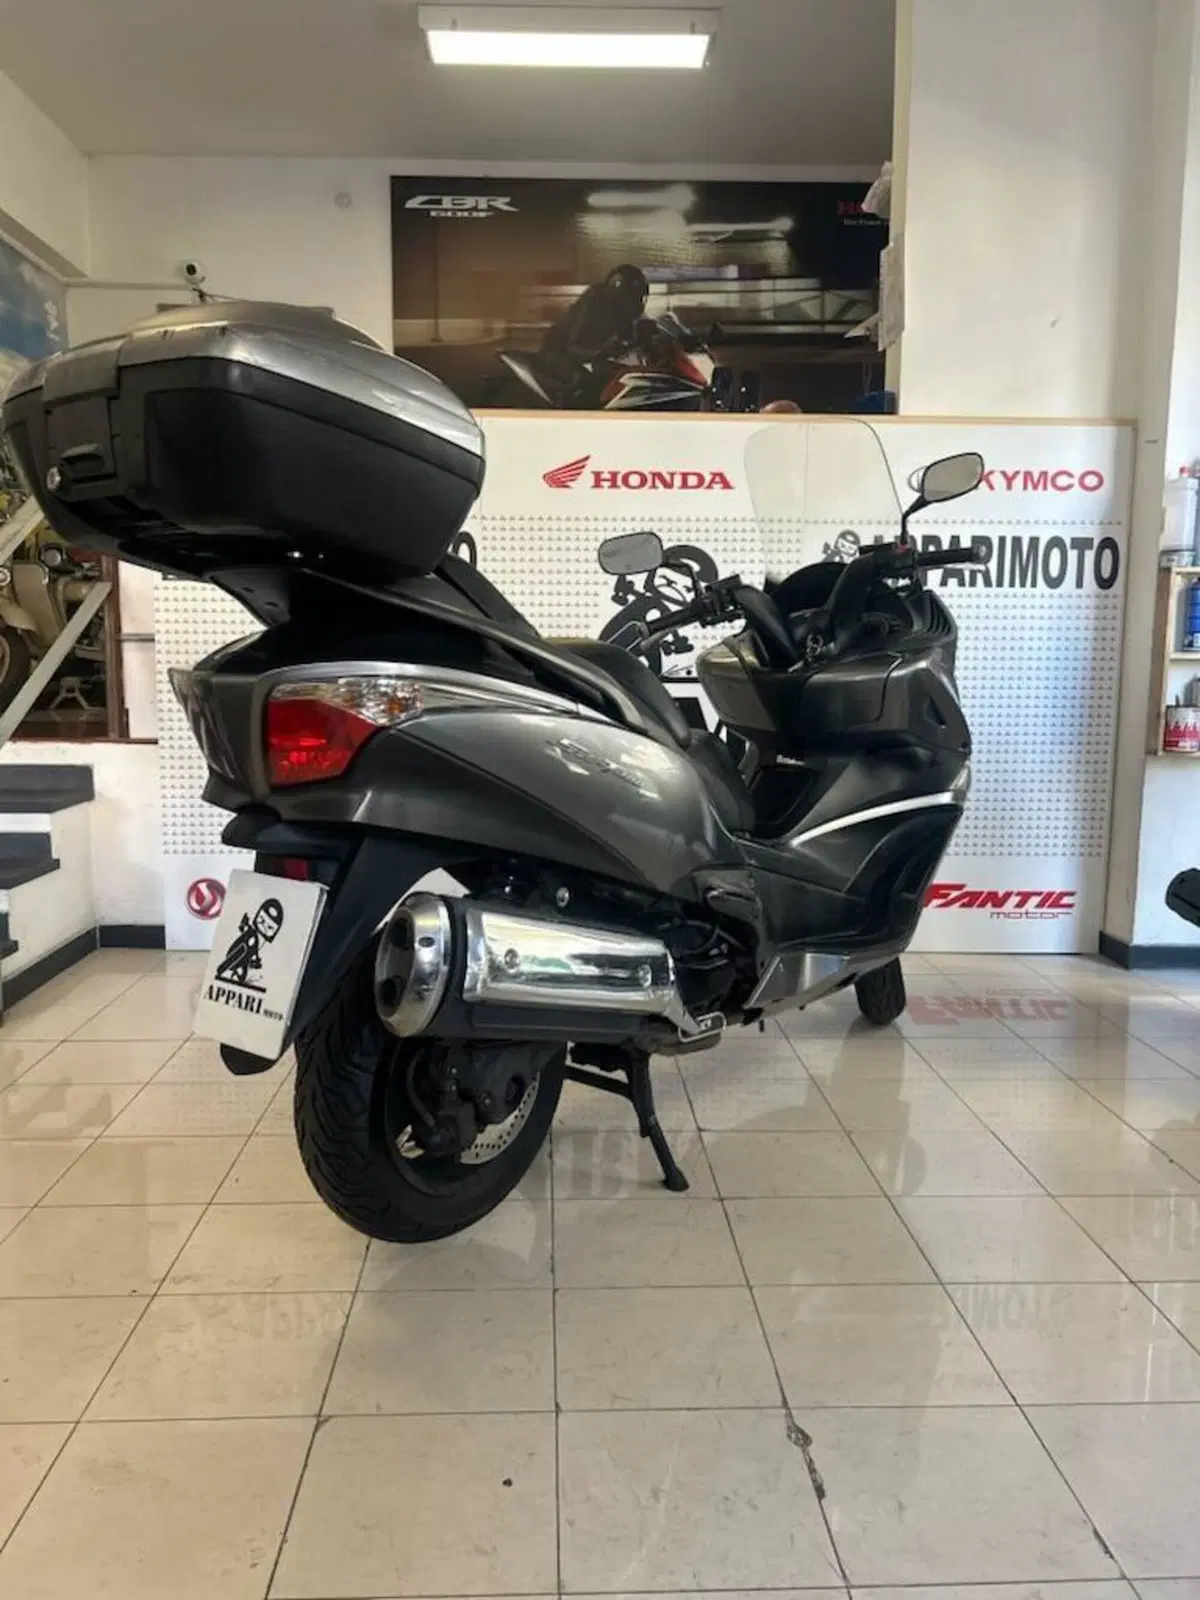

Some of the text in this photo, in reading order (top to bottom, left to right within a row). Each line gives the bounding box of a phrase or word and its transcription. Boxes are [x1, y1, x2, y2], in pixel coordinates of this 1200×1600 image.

[404, 194, 520, 212] CBR
[590, 470, 735, 490] HONDA
[981, 469, 1105, 493] KYMCO
[873, 534, 1120, 590] PARIMOTO
[924, 883, 1077, 909] FANTIC
[990, 910, 1073, 920] motor
[203, 984, 263, 1014] APPARI
